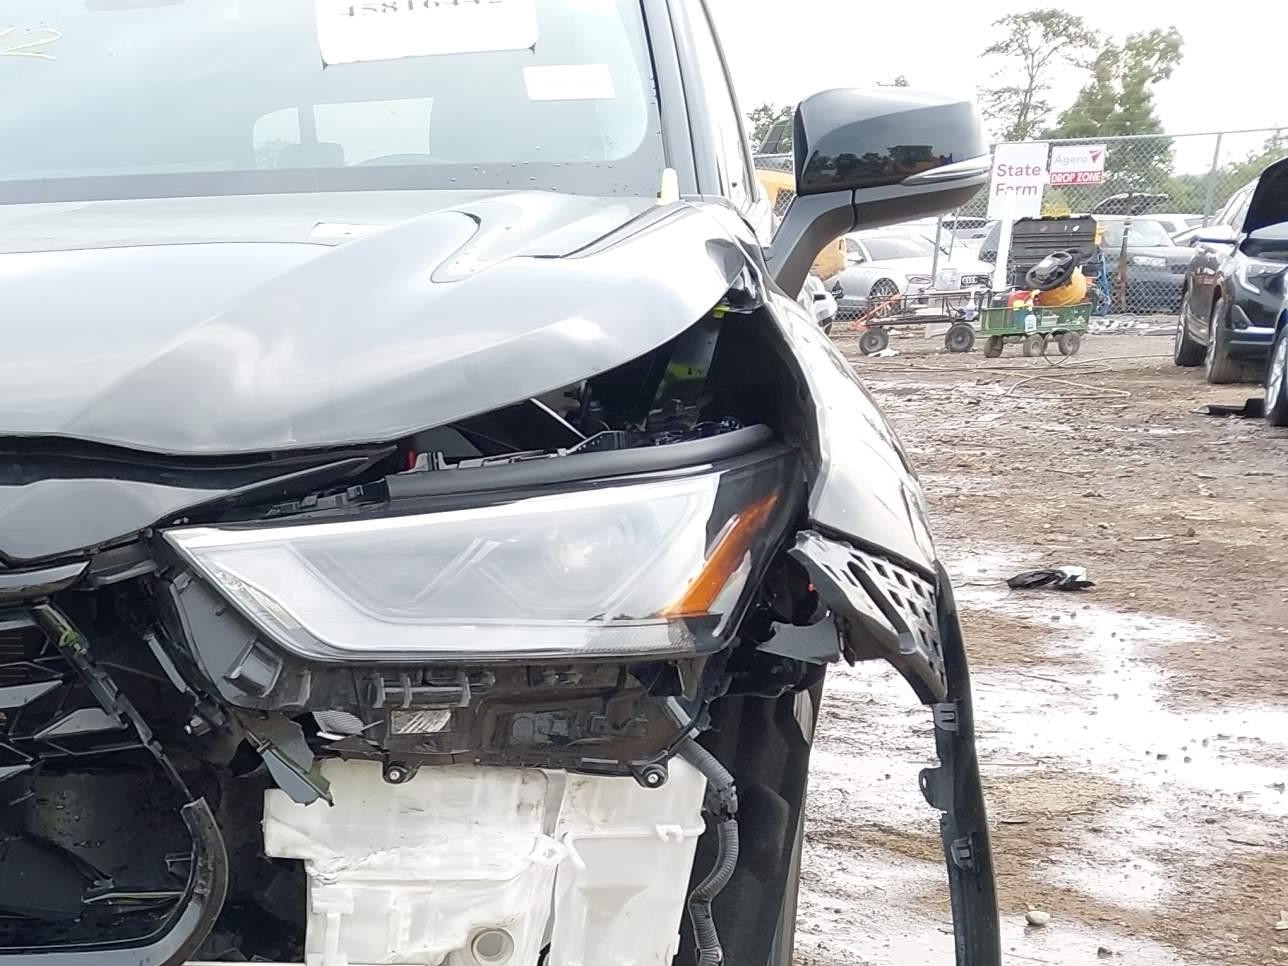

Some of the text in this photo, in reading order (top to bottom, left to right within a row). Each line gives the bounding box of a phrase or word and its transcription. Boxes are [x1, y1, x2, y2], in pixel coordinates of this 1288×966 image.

[1054, 155, 1089, 167] Agero
[996, 163, 1042, 178] State
[1052, 172, 1102, 183] DROP ZONE
